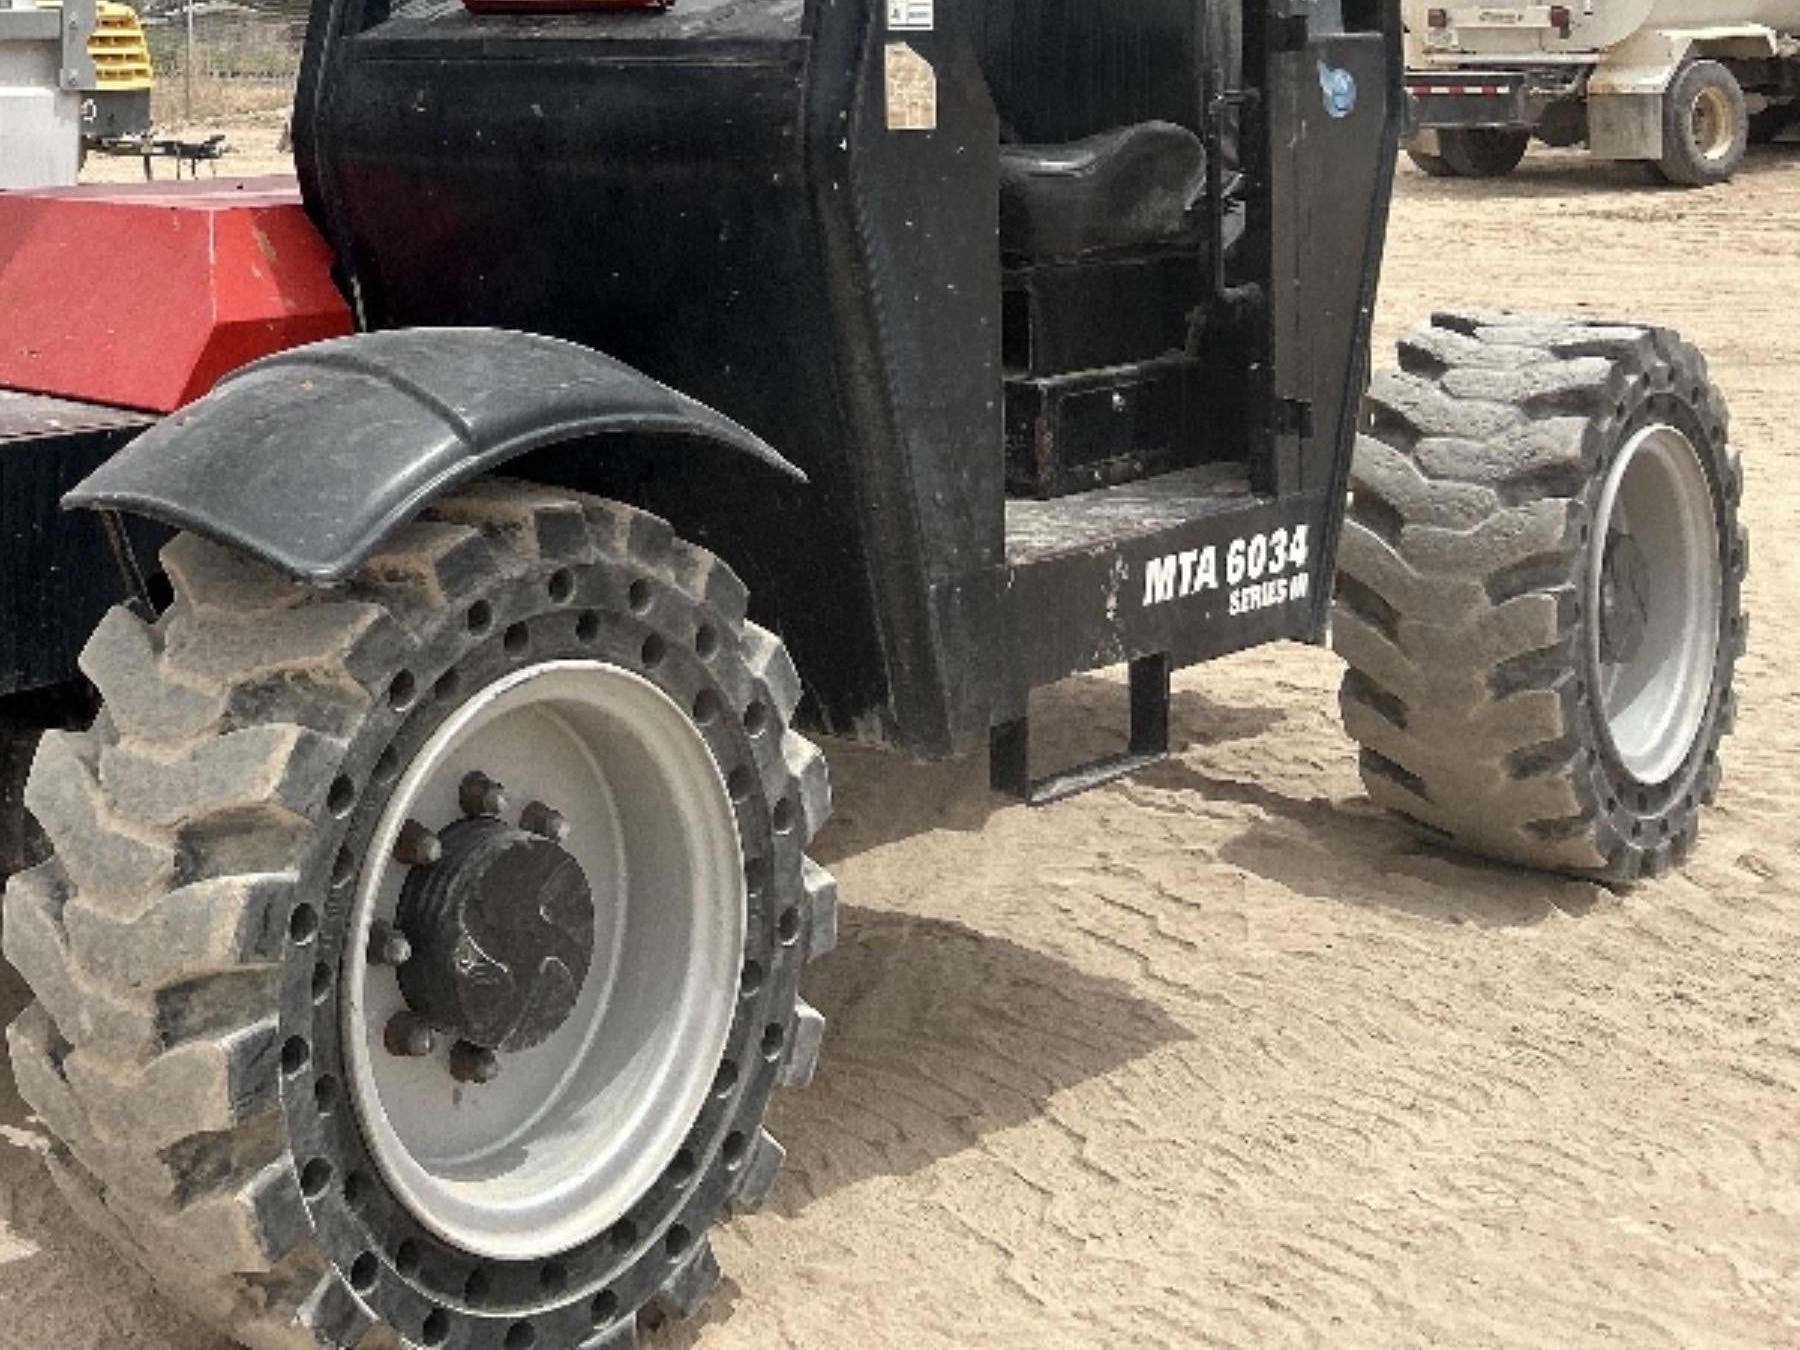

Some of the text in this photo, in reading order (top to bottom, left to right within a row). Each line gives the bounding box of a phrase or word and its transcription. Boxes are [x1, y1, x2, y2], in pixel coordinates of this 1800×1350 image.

[1142, 524, 1309, 607] MTA 6034
[1228, 577, 1288, 616] SERIES
